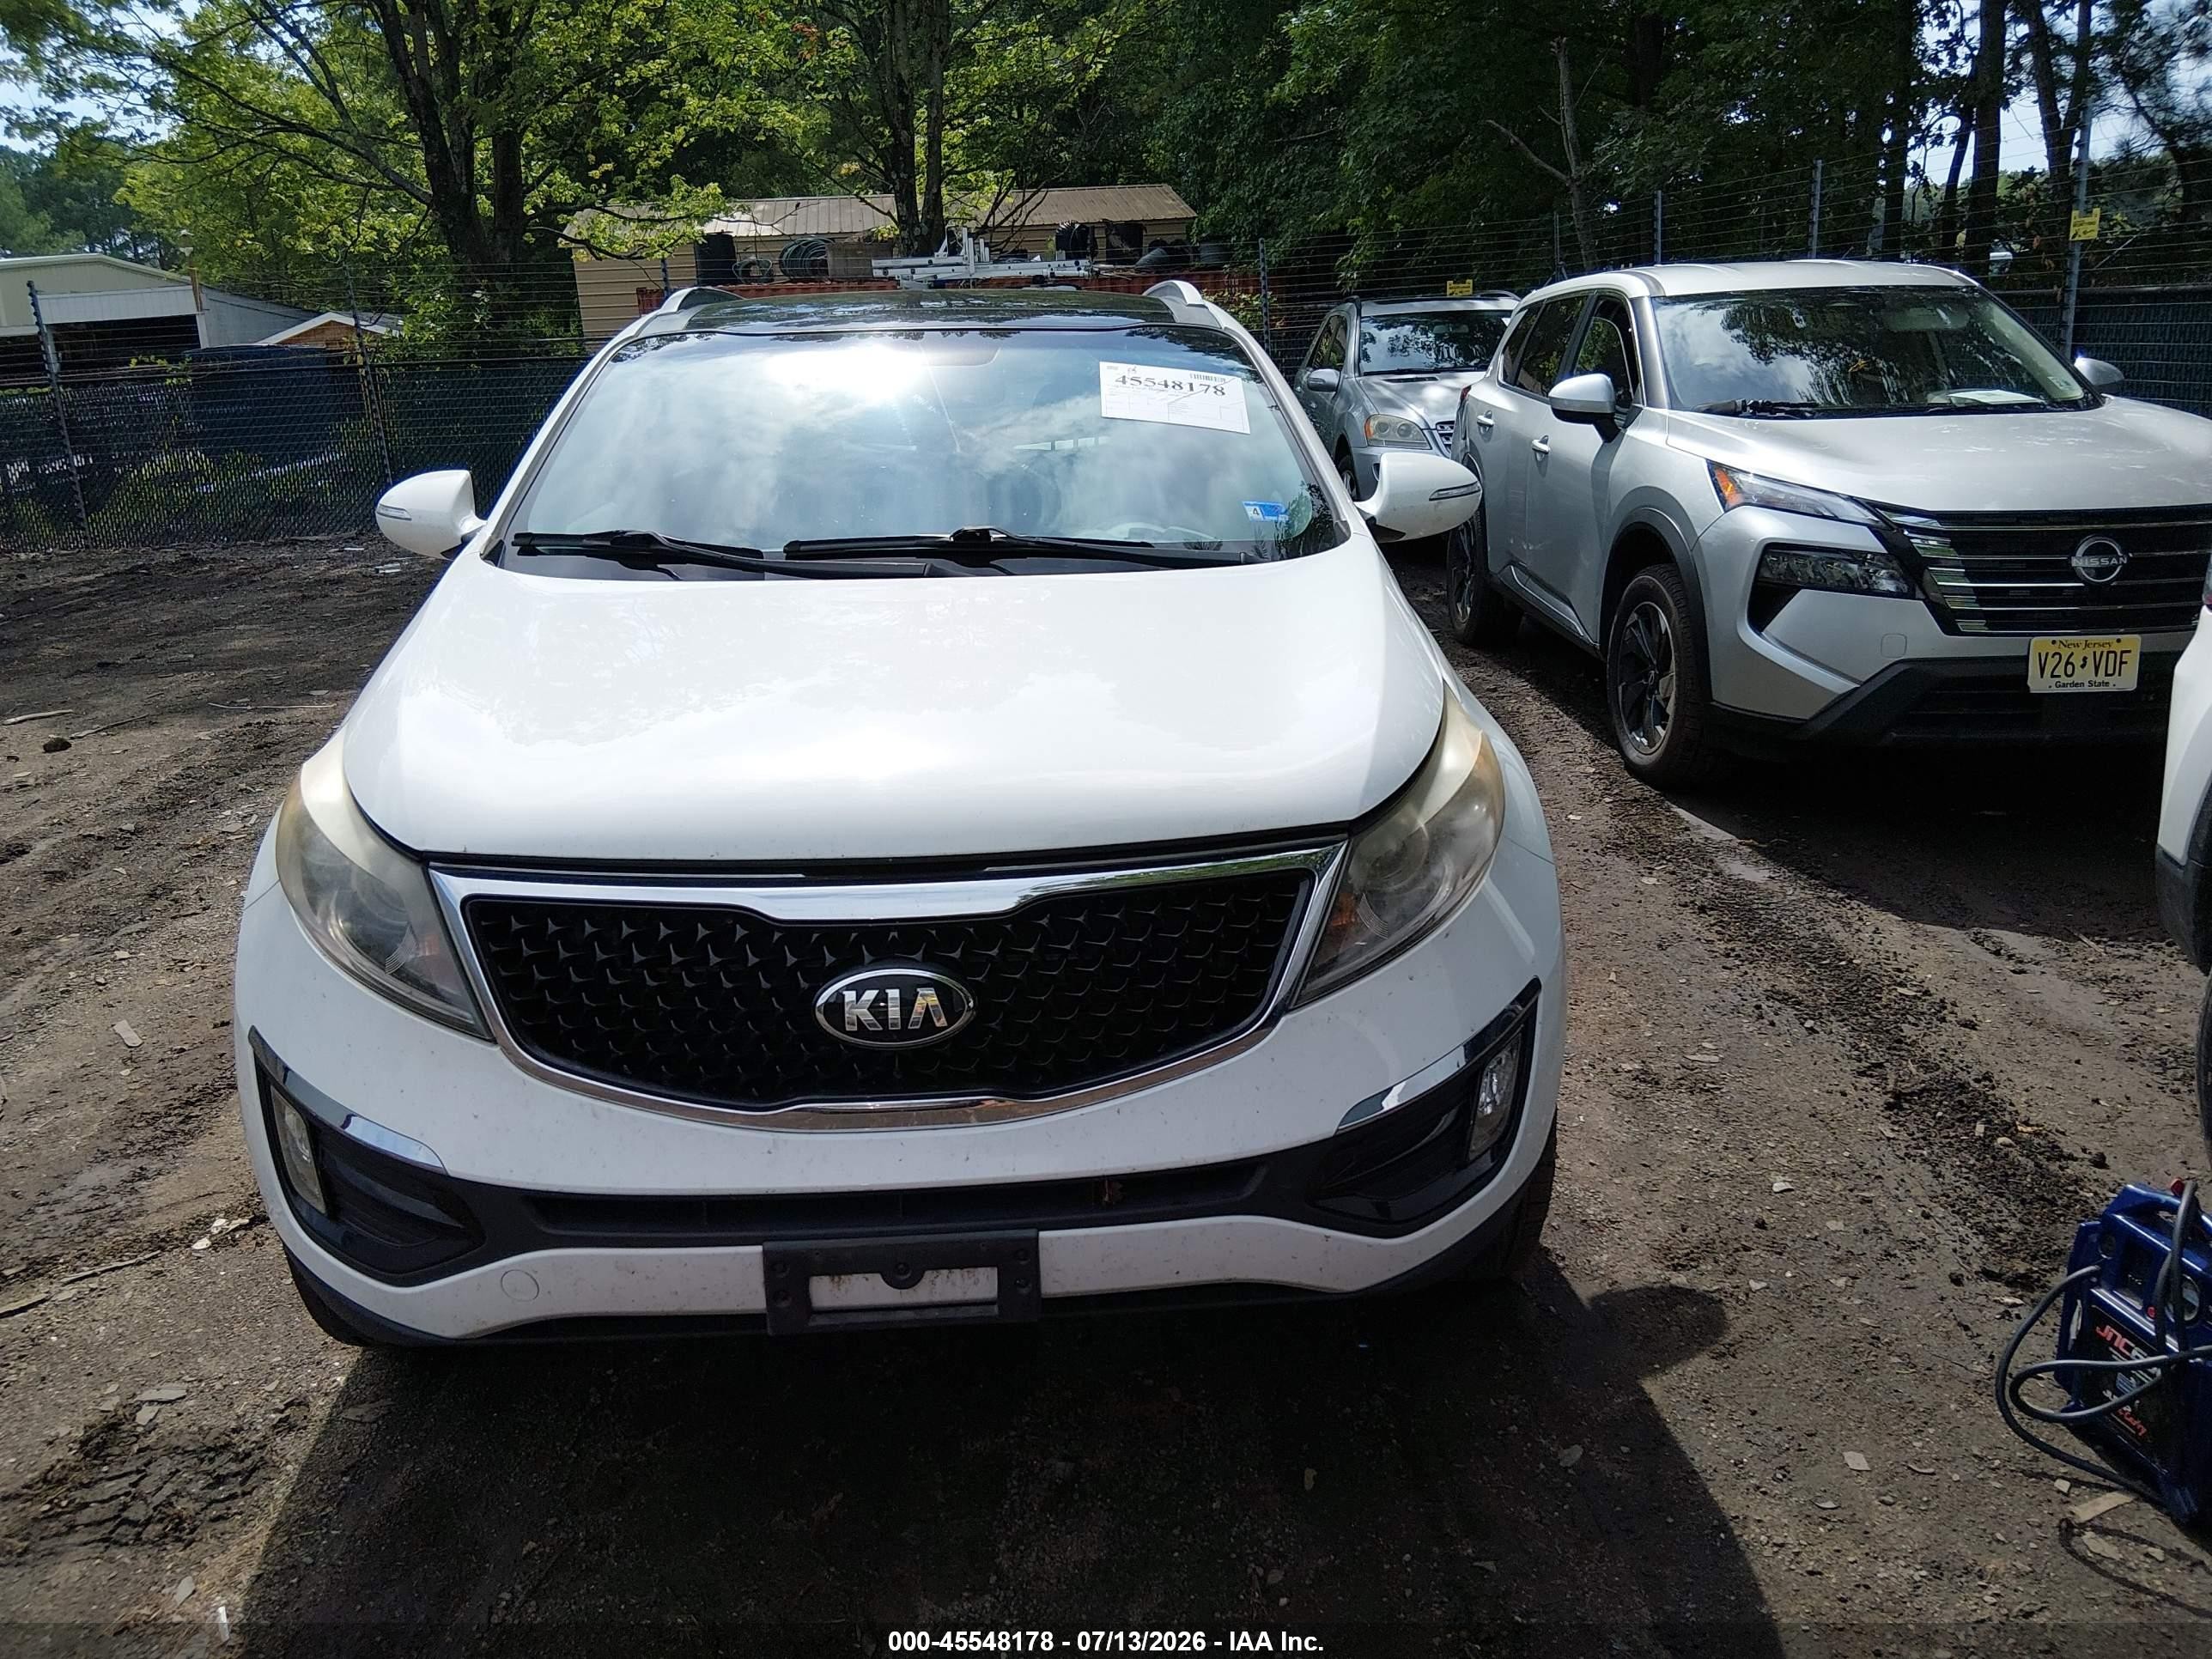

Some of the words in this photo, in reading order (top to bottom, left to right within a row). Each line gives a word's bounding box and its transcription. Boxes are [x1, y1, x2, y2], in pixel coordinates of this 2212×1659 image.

[1115, 374, 1226, 397] 45548178
[2071, 556, 2128, 568] NISSAN
[2058, 639, 2081, 649] New
[2081, 639, 2114, 650] Jersey
[2038, 651, 2075, 679] V26
[2093, 649, 2132, 678] VDF
[2054, 680, 2085, 689] Garden
[2087, 679, 2111, 688] State
[842, 987, 948, 1031] KIA
